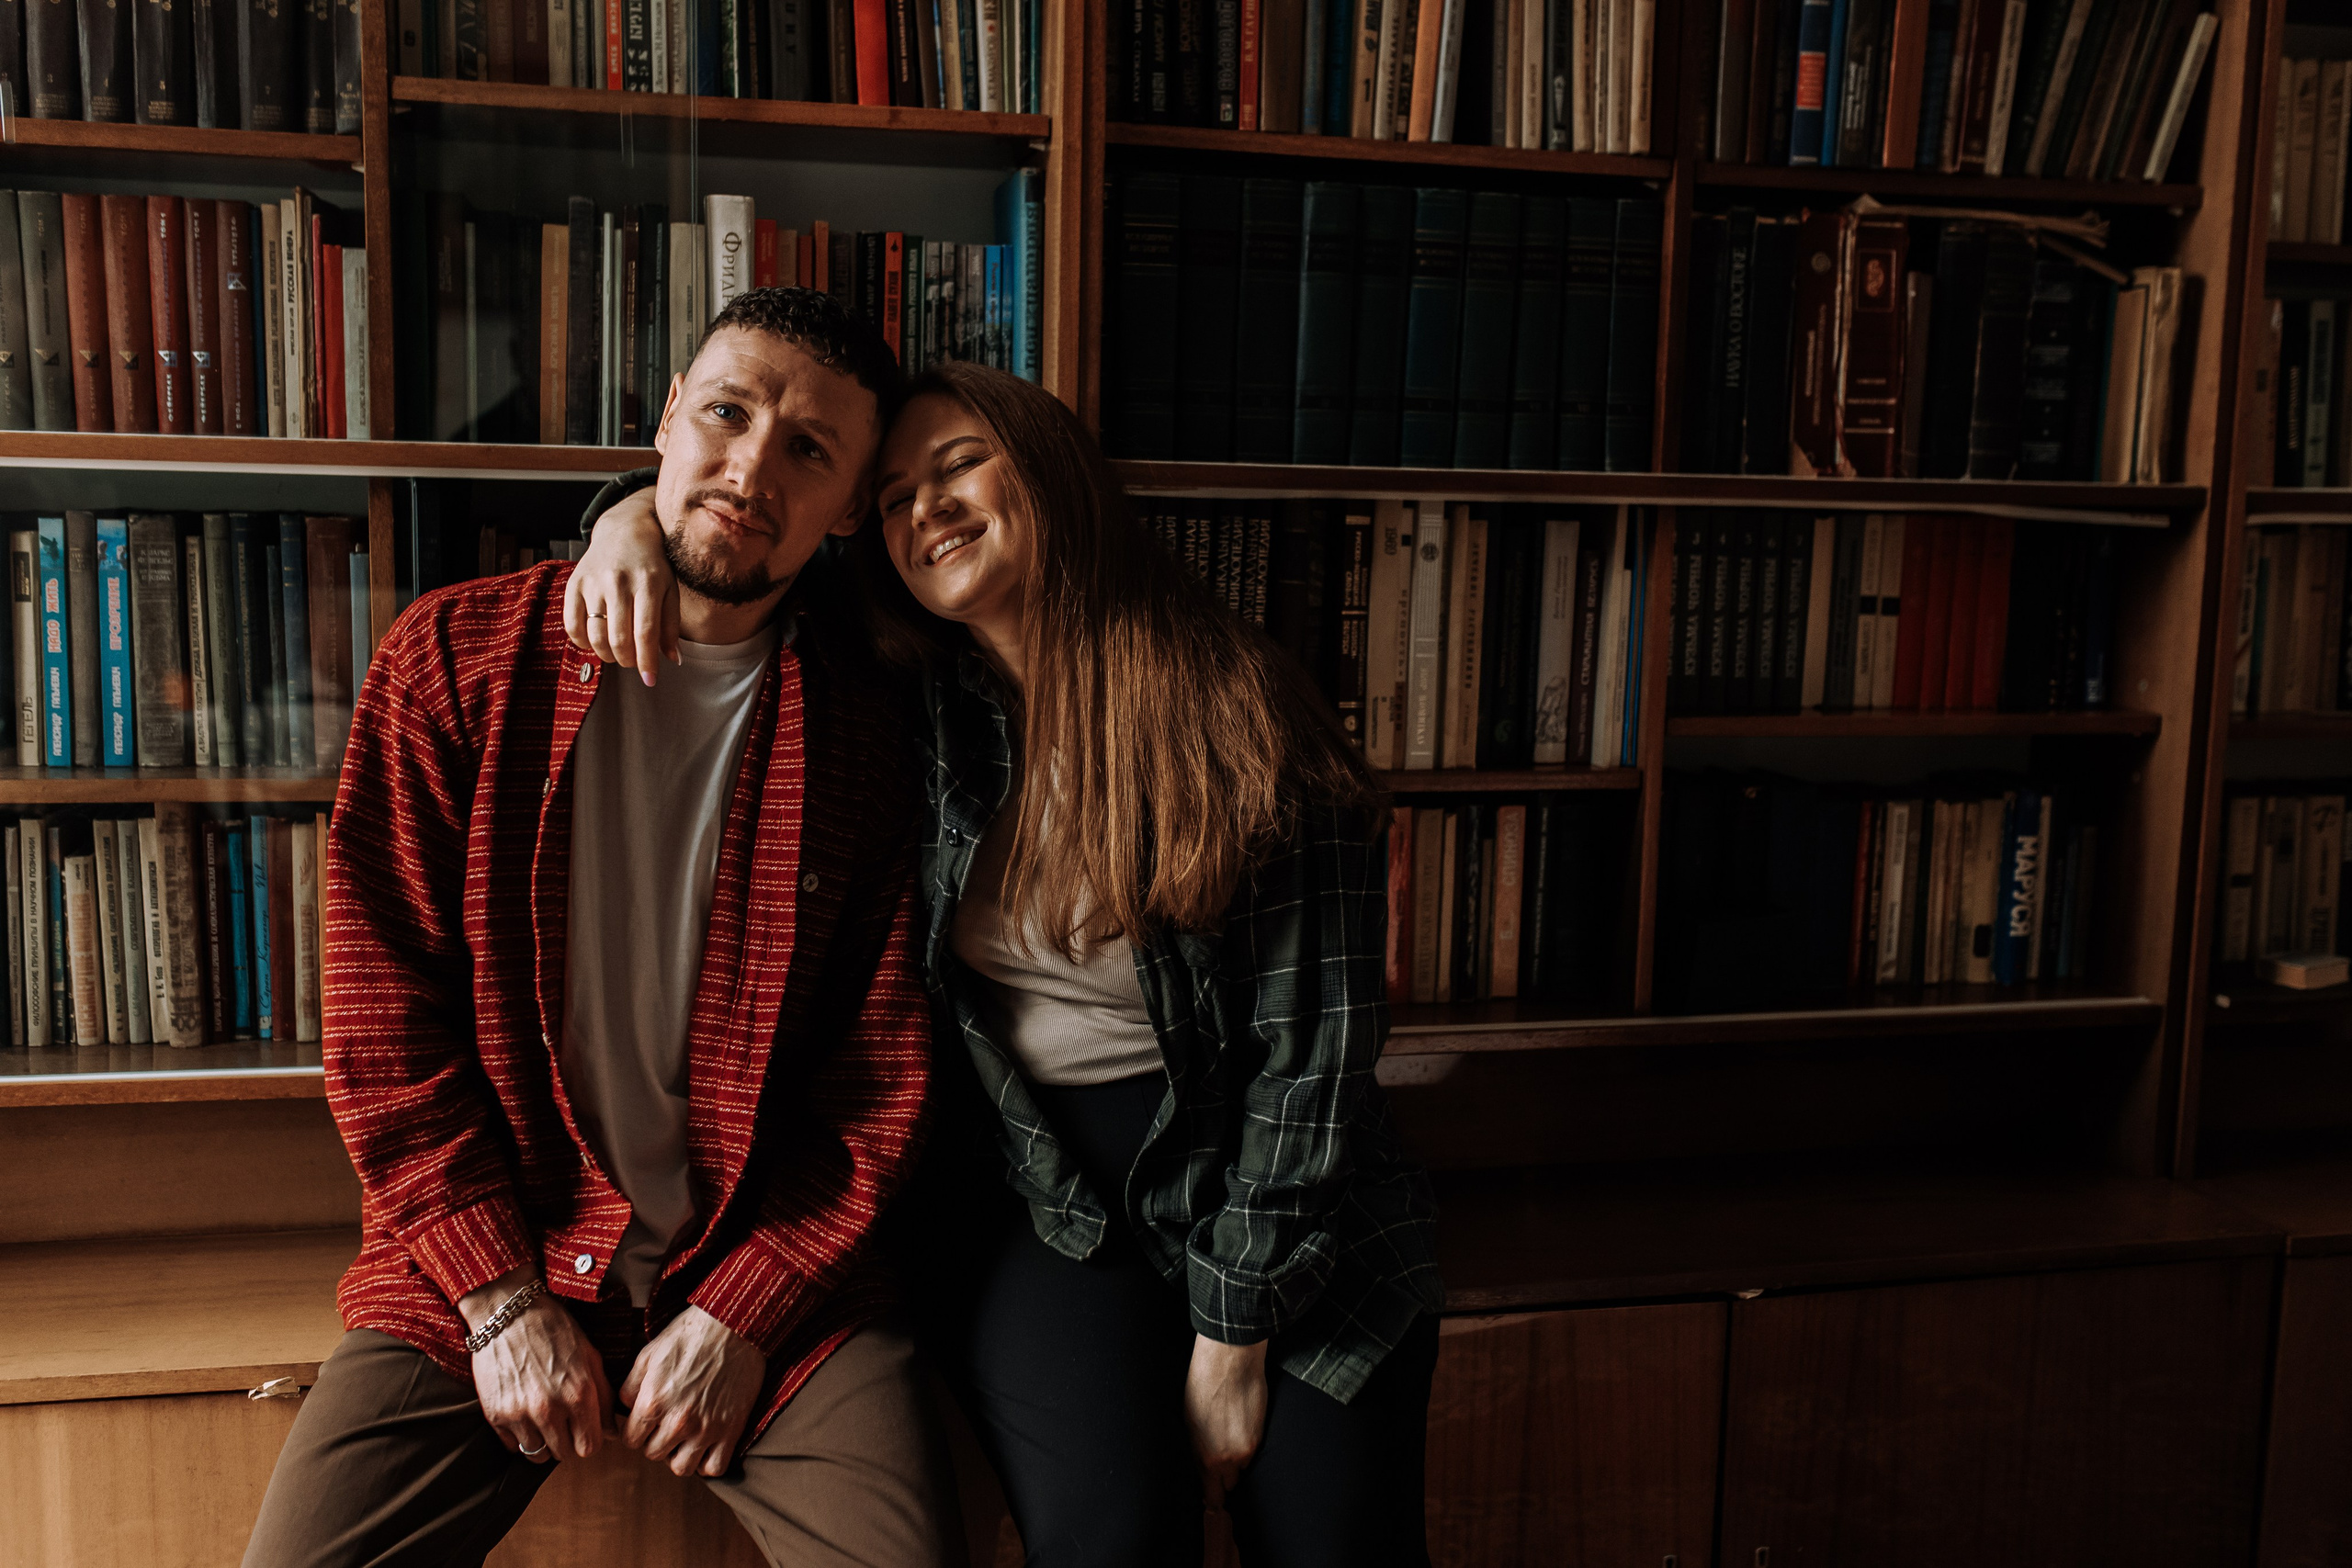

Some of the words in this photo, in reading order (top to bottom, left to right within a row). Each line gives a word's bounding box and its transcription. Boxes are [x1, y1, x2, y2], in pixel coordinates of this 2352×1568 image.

[160, 220, 168, 239] ТОМ
[285, 230, 294, 262] ВЕНЕРА
[287, 264, 295, 304] РУССКАЯ
[1728, 320, 1743, 333] О
[1725, 335, 1743, 388] НАУКА
[1216, 514, 1230, 602] ЗЫКАЛЬНАЯ
[1385, 526, 1397, 556] 1969
[1254, 518, 1271, 628] ЭНЦИКЛОПЕДИЯ
[45, 578, 61, 613] ЖИТЬ
[107, 577, 122, 650] ПРОЗРЕНИЕ
[46, 619, 63, 652] НАДО
[20, 696, 34, 743] ГЕГЕЛЬ
[28, 837, 37, 878] ПОЗНАНИИ
[125, 835, 135, 889] КАПИТАЛИЗМ
[1501, 812, 1520, 886] СПИНОЗА
[28, 880, 38, 916] НАУЧНОМ
[209, 866, 219, 935] СОЦИАЛИСТИЧЕСКАЯ
[2009, 835, 2039, 937] МАРУСЯ
[127, 892, 139, 952] СОВРЕМЕННЫЙ
[29, 926, 40, 968] ПРИНЦИПЫ
[30, 970, 40, 1026] ФИЛОСОФСКИЕ
[213, 1000, 222, 1032] НАУЧНОЕ
